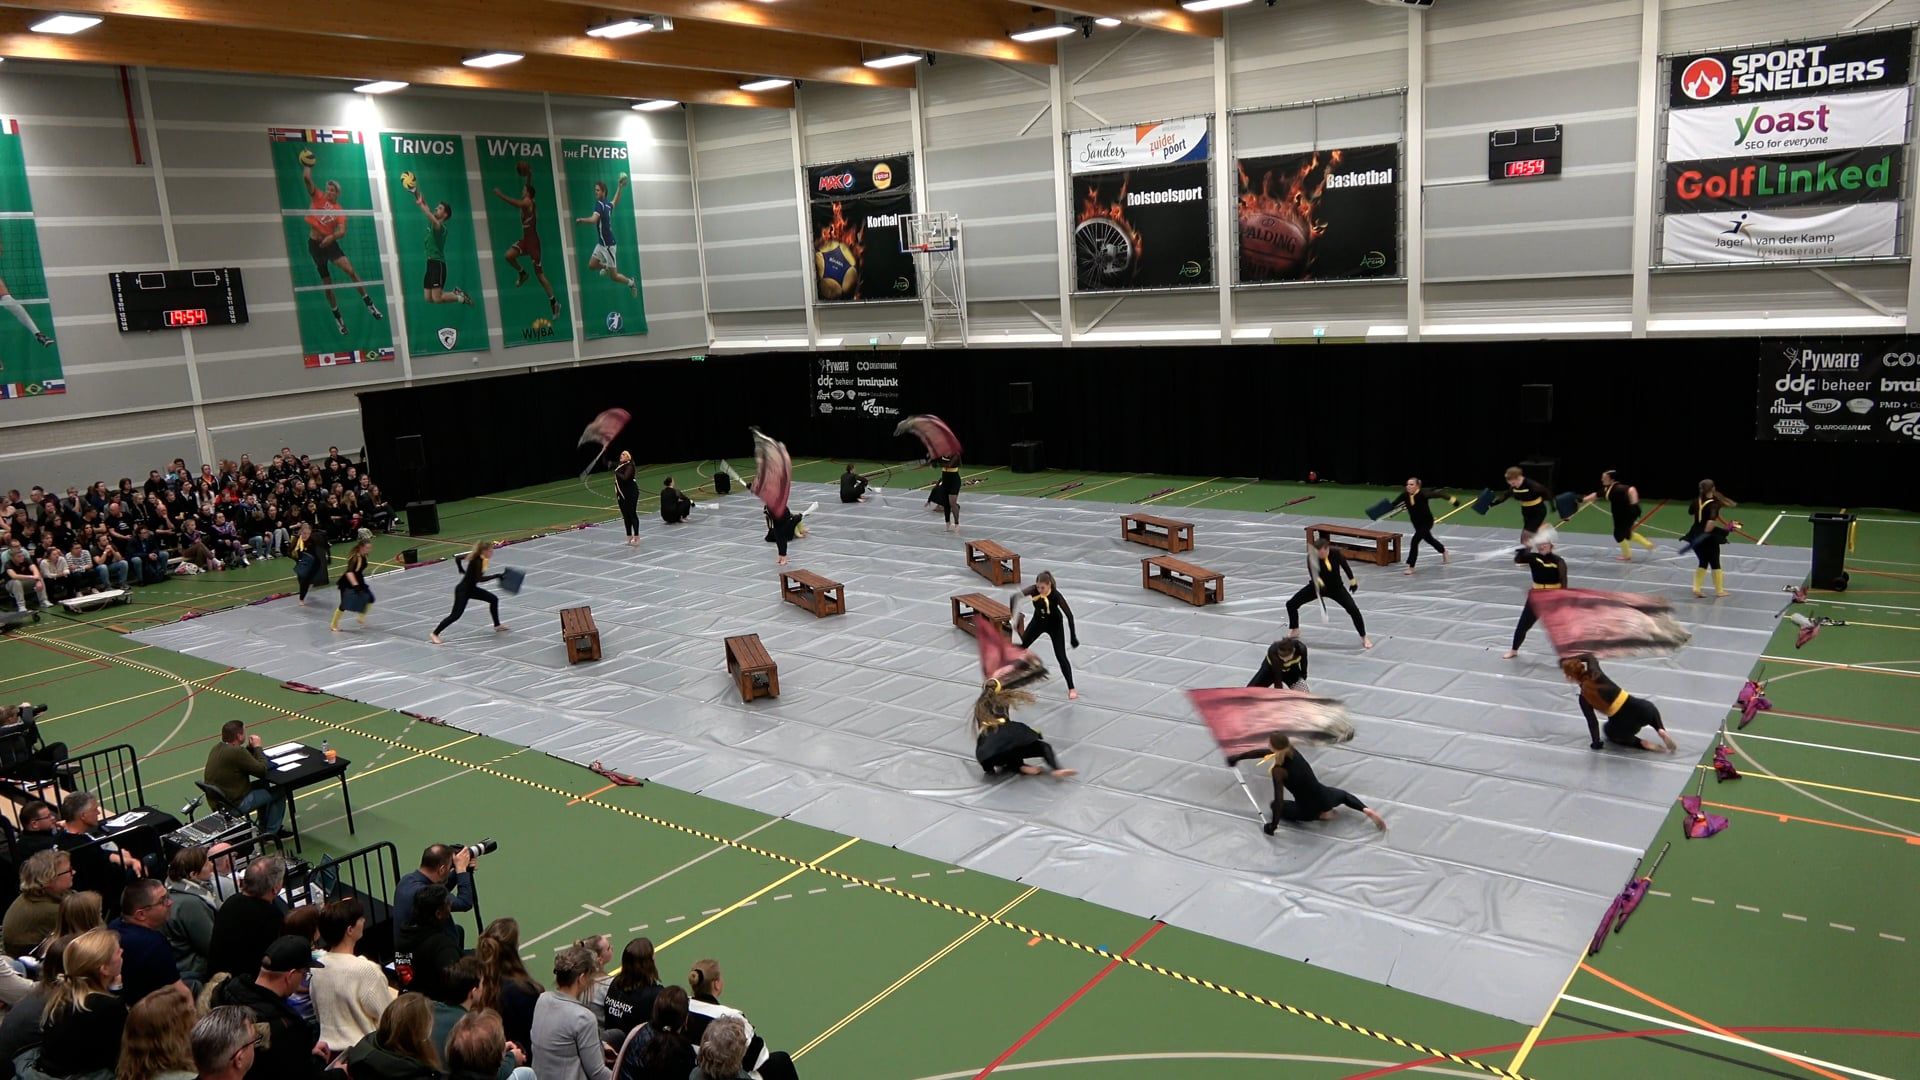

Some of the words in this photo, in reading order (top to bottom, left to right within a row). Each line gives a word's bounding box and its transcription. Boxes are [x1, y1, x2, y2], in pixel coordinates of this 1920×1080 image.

[1732, 45, 1827, 77] SPORT
[1738, 58, 1886, 95] SNELDERS
[391, 136, 454, 155] TRIVOS
[487, 139, 543, 157] WYBA
[1149, 132, 1176, 152] zuider
[1163, 138, 1187, 160] poort
[1745, 140, 1764, 150] SEO
[1767, 138, 1782, 148] for
[1783, 135, 1828, 150] everyone
[563, 150, 578, 159] THE
[580, 144, 627, 159] FLYERS
[1080, 141, 1127, 163] Sanders
[1511, 160, 1545, 175] 19:54
[818, 175, 844, 191] MAX
[1326, 168, 1393, 189] Basketbal
[1676, 154, 1891, 200] GolfLinked
[1127, 186, 1203, 206] Rolstoelsport
[867, 213, 898, 228] Korfbal
[1715, 237, 1745, 249] Jager
[1755, 236, 1775, 246] van
[1778, 234, 1798, 245] der
[1800, 233, 1835, 246] Kamp
[170, 310, 204, 325] 19:54
[827, 360, 849, 373] Pyware
[1802, 349, 1860, 371] Pyware
[817, 375, 833, 388] ddf
[857, 377, 898, 387] brainpink
[1775, 374, 1816, 396] ddf
[1821, 378, 1872, 391] beheer
[869, 406, 884, 416] cgn
[608, 1006, 624, 1018] CREW
